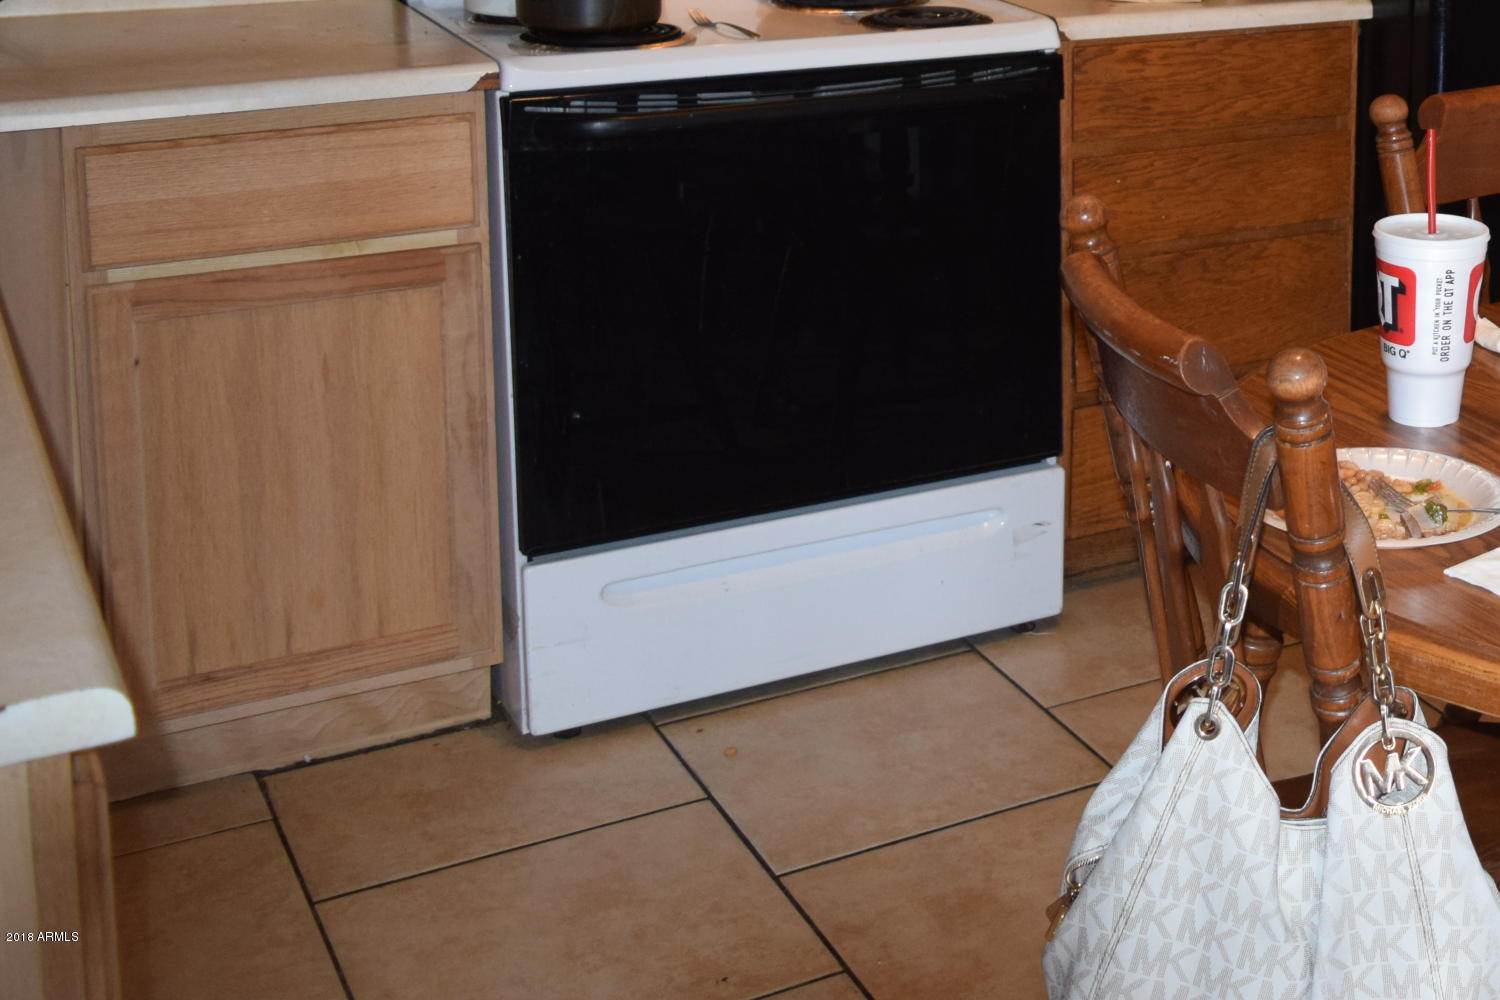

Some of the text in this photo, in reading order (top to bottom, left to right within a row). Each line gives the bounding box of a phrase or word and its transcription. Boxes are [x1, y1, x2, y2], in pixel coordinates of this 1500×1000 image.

[1433, 298, 1442, 311] YOUR
[1440, 268, 1456, 363] ORDER ON THE QT APP
[1383, 342, 1396, 356] BIG
[1359, 745, 1429, 799] MK
